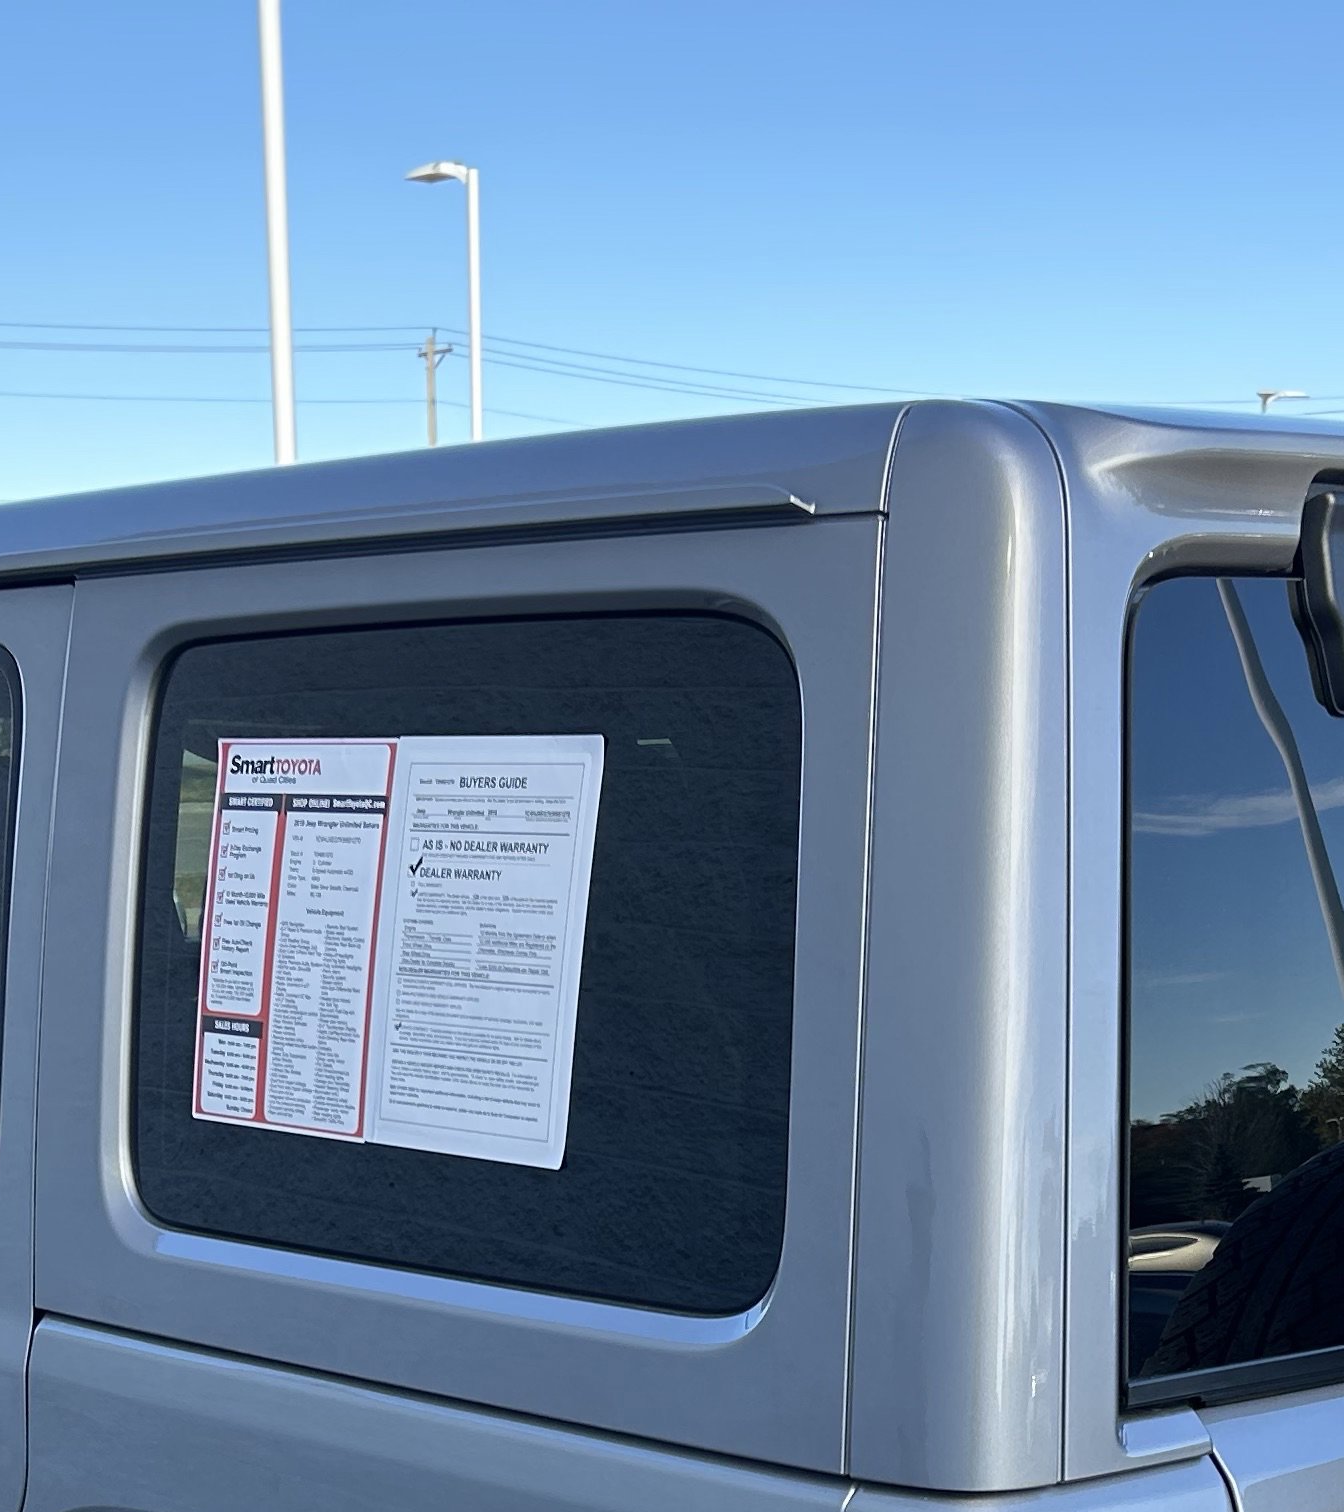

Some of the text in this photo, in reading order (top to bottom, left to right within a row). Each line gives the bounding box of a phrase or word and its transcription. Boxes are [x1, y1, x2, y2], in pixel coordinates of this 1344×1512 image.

[259, 776, 277, 784] Quad
[278, 776, 296, 785] Cities
[459, 776, 496, 789] BUYERS
[498, 776, 527, 789] GUIDE
[422, 839, 433, 850] AS
[435, 839, 443, 850] IS
[449, 840, 462, 851] NO
[464, 840, 498, 852] DEALER
[500, 841, 549, 854] WARRANTY
[419, 867, 502, 881] DEALER WARRANTY
